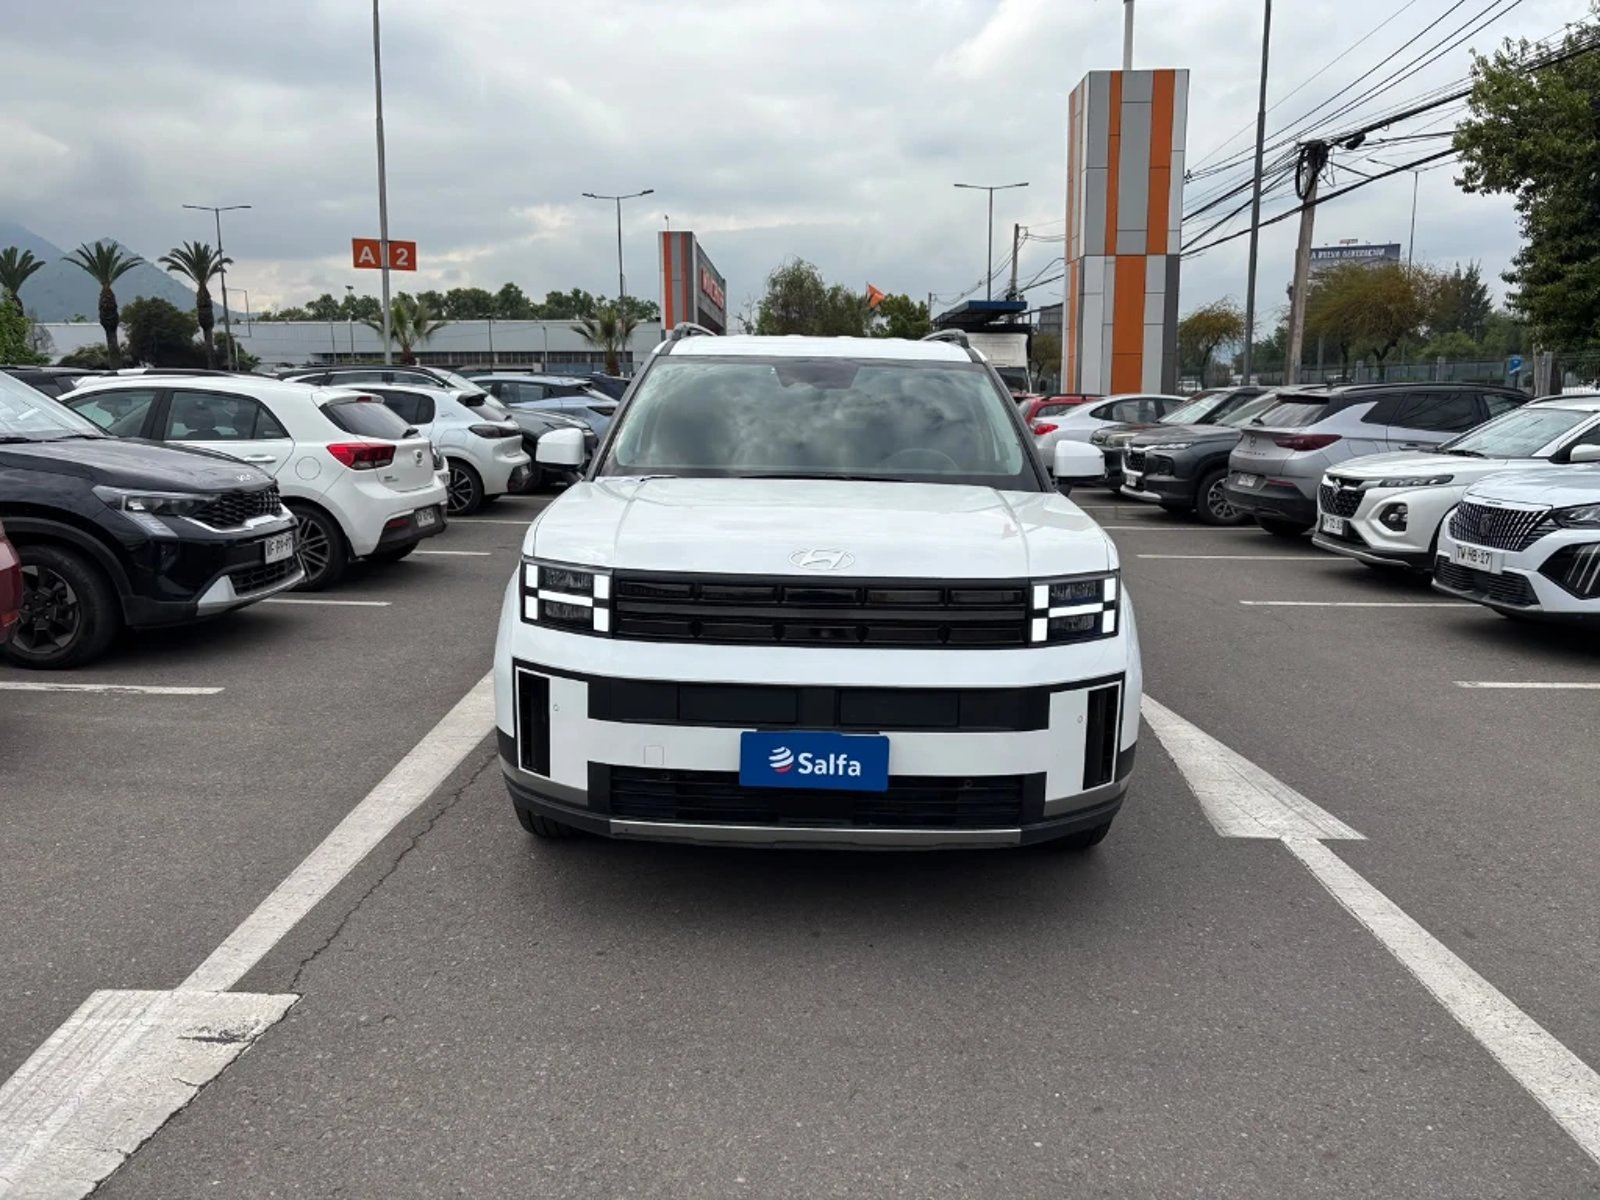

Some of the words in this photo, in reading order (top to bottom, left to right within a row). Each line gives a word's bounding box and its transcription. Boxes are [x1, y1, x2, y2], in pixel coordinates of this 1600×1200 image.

[359, 246, 376, 265] A
[396, 247, 409, 267] 2
[797, 752, 861, 776] Salfa
